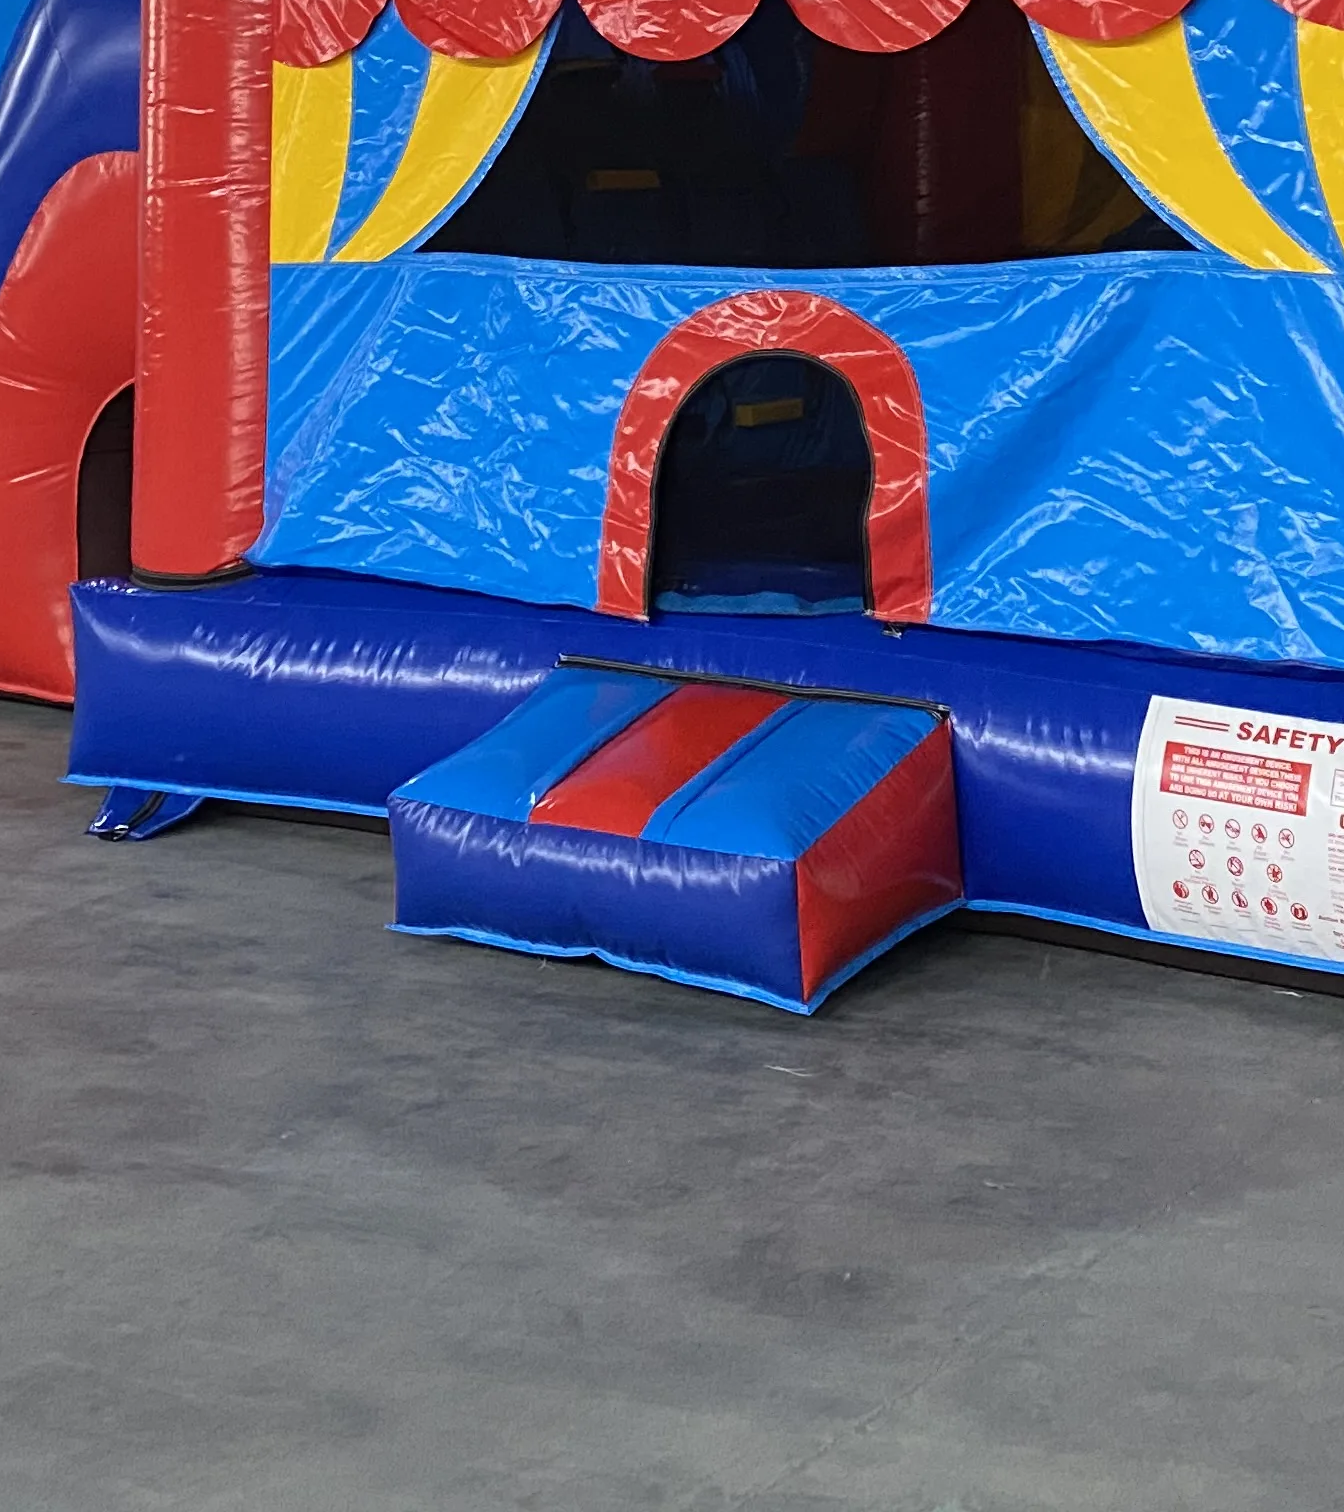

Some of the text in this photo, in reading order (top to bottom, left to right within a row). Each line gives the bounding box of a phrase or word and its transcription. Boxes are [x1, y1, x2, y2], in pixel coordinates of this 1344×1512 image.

[1237, 721, 1344, 754] SAFETY
[1190, 756, 1204, 766] ALL
[1217, 790, 1229, 800] AT
[1229, 792, 1254, 805] YOUR
[1253, 796, 1274, 808] OWN
